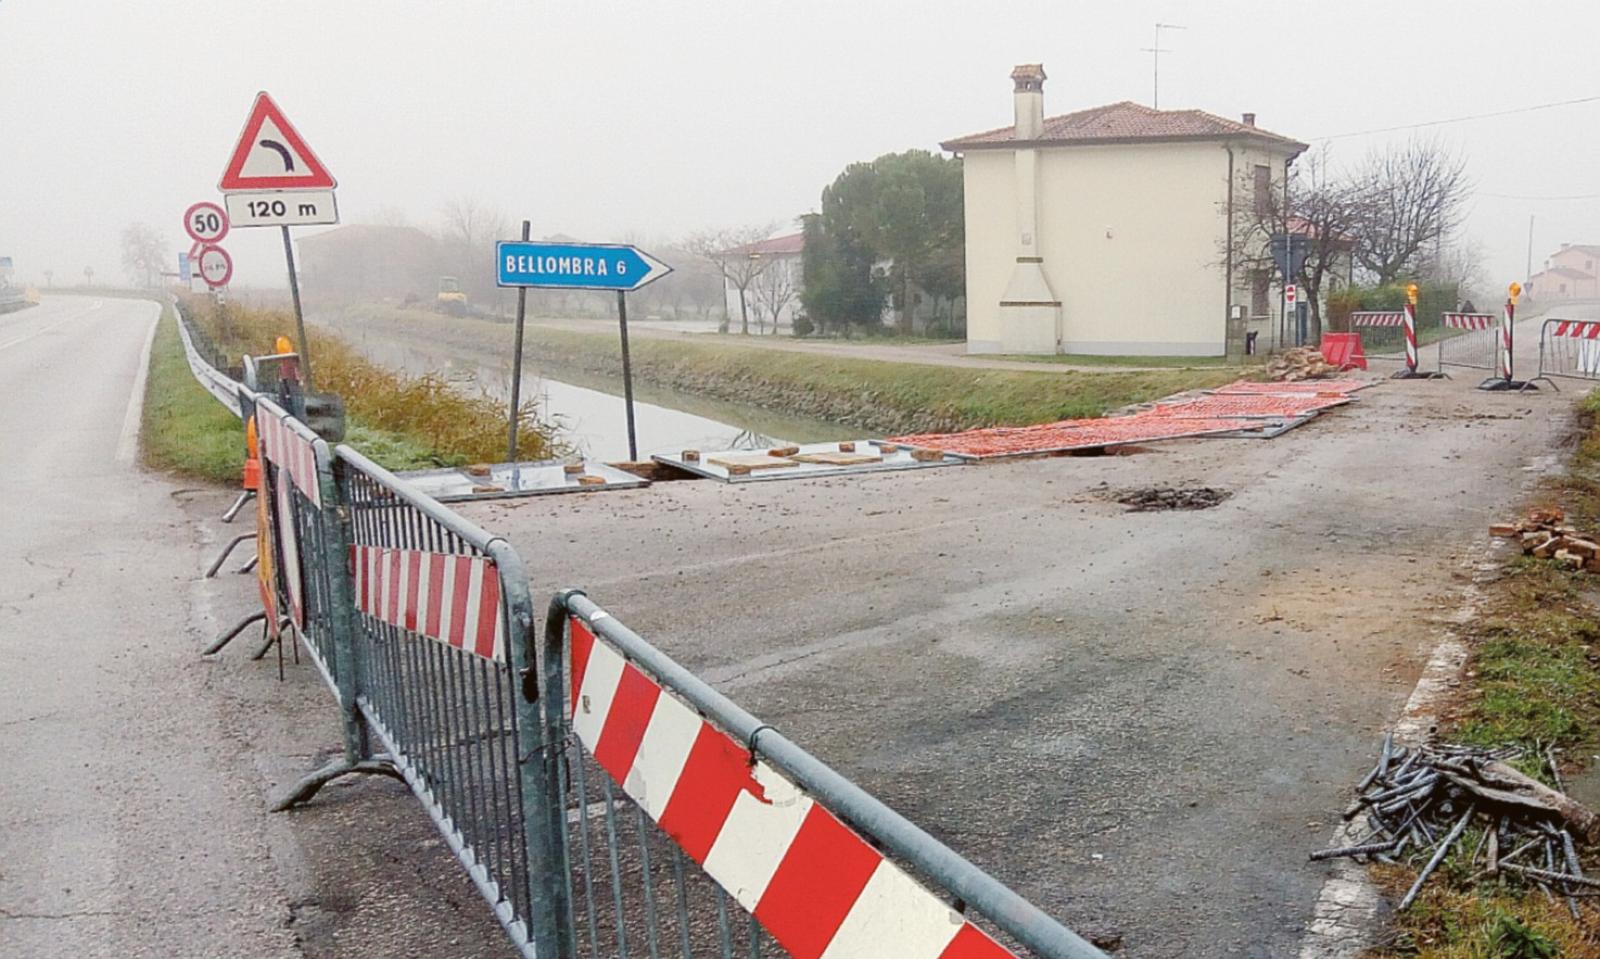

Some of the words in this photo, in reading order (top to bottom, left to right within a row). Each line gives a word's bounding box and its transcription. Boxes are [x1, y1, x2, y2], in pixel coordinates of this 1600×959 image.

[248, 200, 286, 218] 120
[298, 203, 317, 216] m
[195, 213, 220, 233] 50
[506, 255, 608, 276] BELLOMBRA
[616, 260, 627, 275] 6
